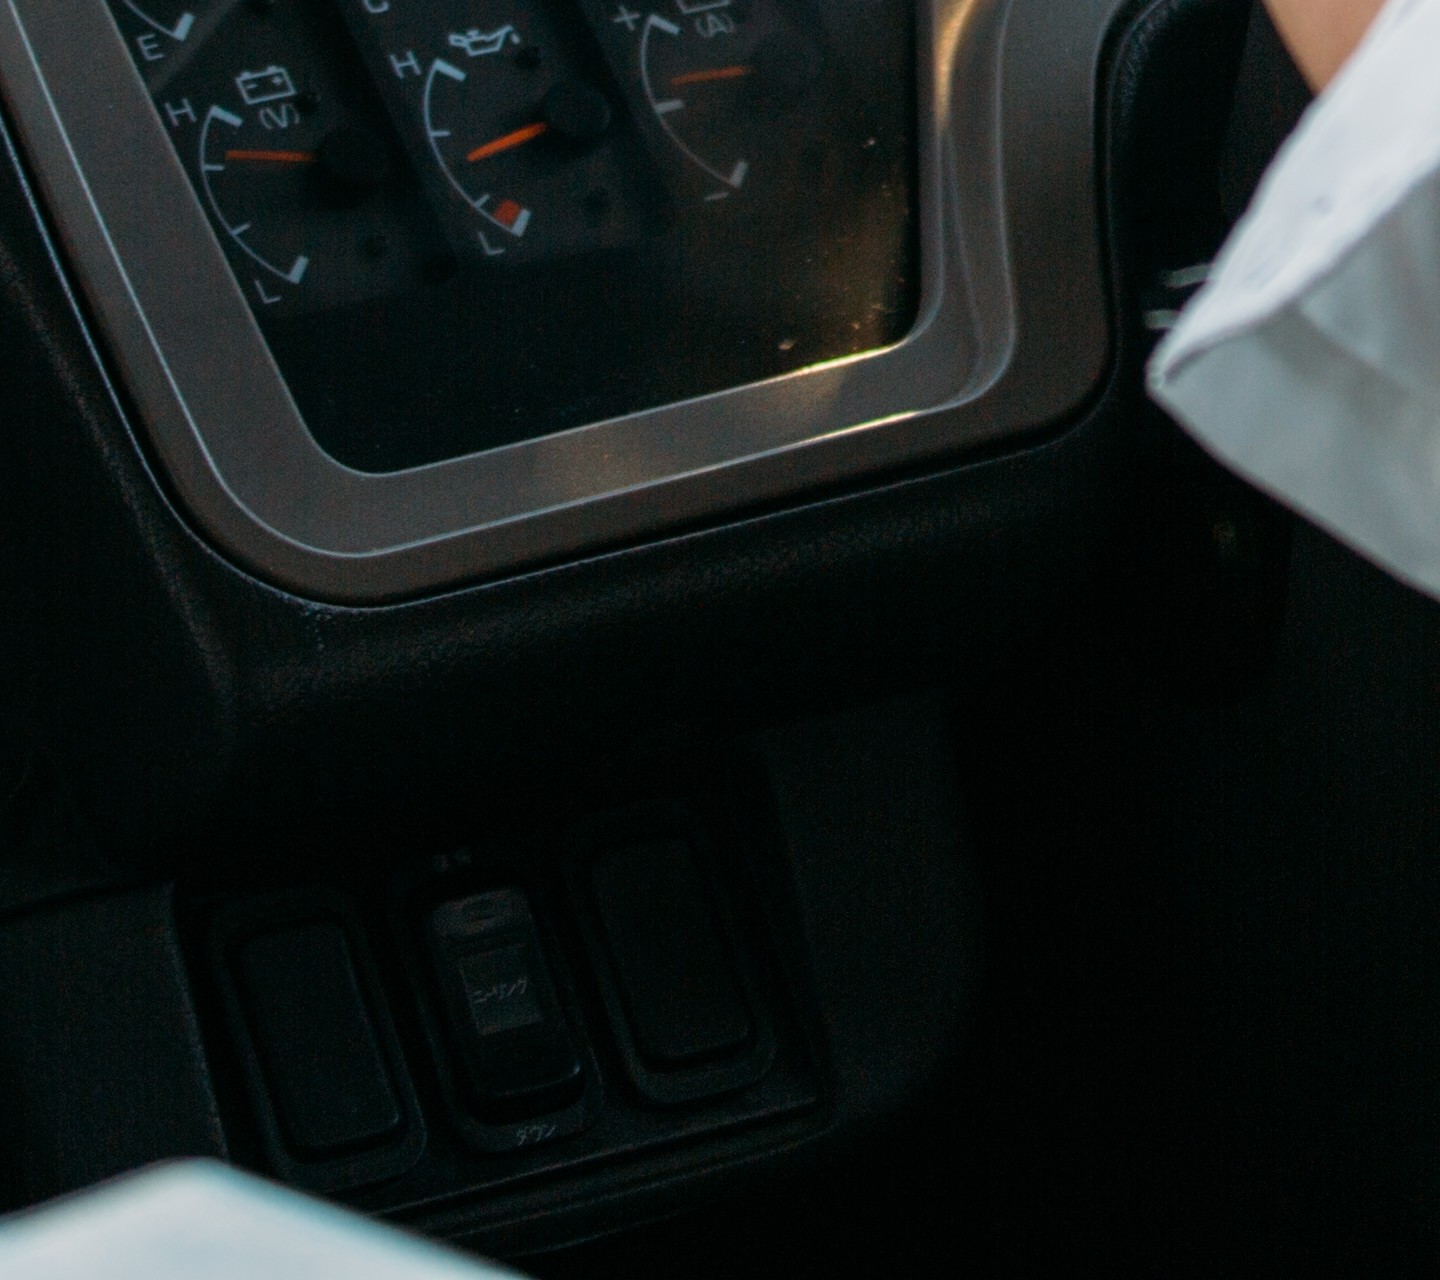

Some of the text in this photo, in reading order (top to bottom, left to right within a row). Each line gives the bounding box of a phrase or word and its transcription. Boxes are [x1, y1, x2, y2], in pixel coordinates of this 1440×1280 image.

[137, 33, 165, 61] E
[389, 50, 422, 79] H
[165, 98, 196, 127] H
[478, 231, 505, 257] L
[255, 279, 282, 305] L
